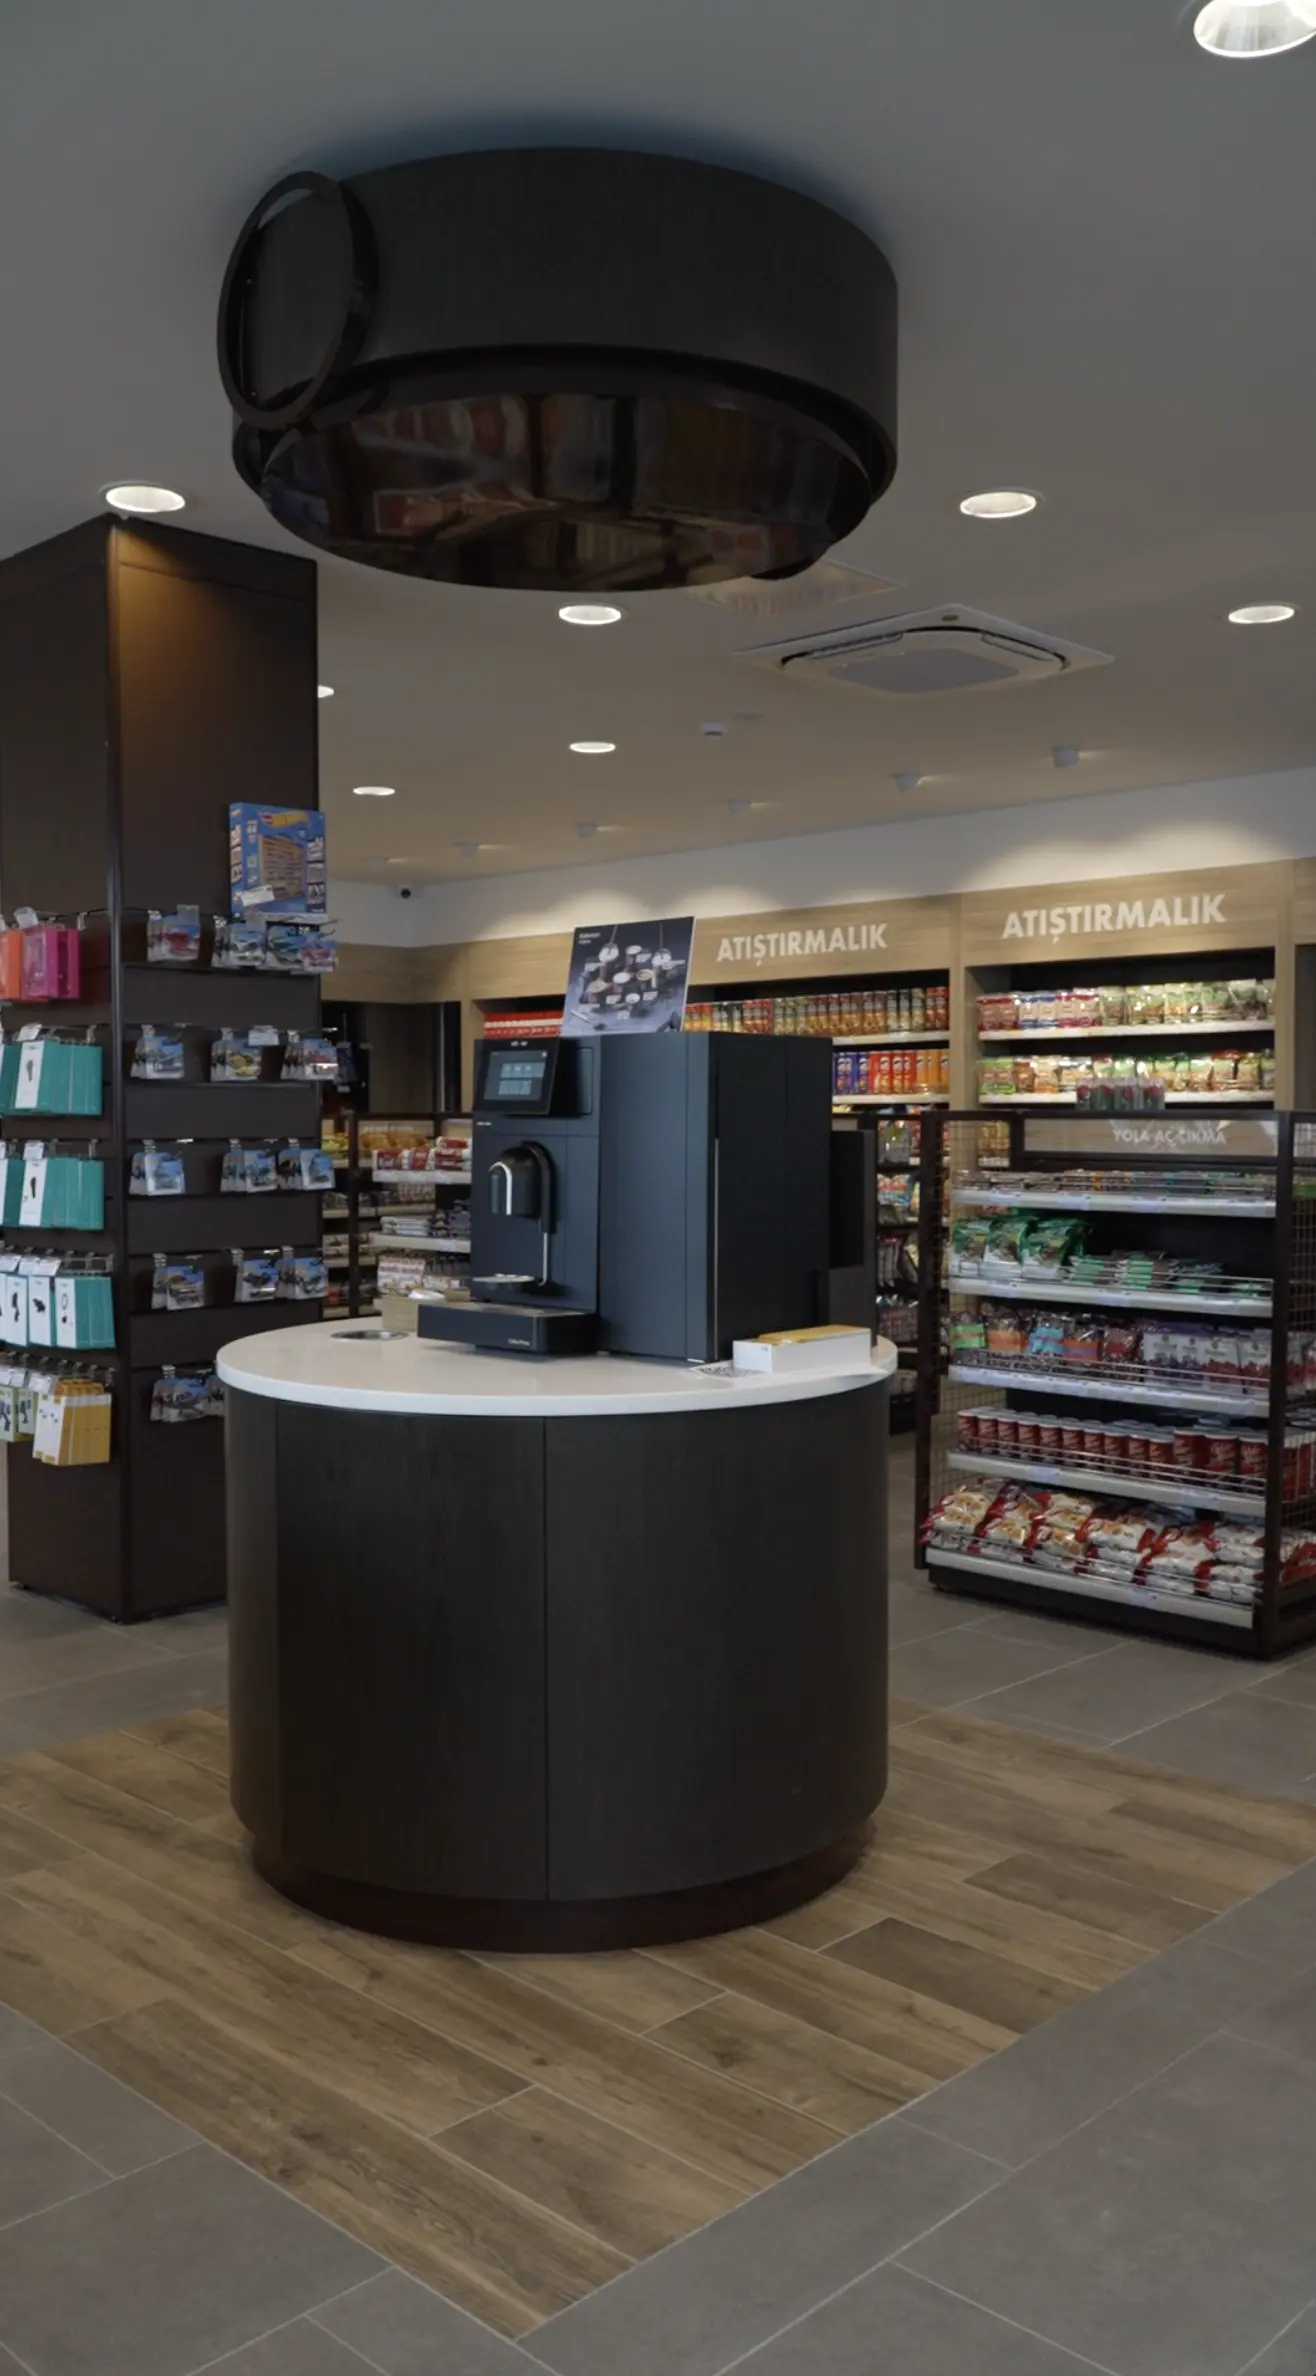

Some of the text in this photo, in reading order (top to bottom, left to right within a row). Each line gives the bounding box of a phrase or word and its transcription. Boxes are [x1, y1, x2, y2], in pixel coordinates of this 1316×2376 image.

[1002, 894, 1227, 944] ATIŞTIRMALIK
[717, 923, 888, 966] ATIŞTIRMALIK
[1112, 1129, 1150, 1144] YOLA
[1154, 1129, 1176, 1147] AÇ
